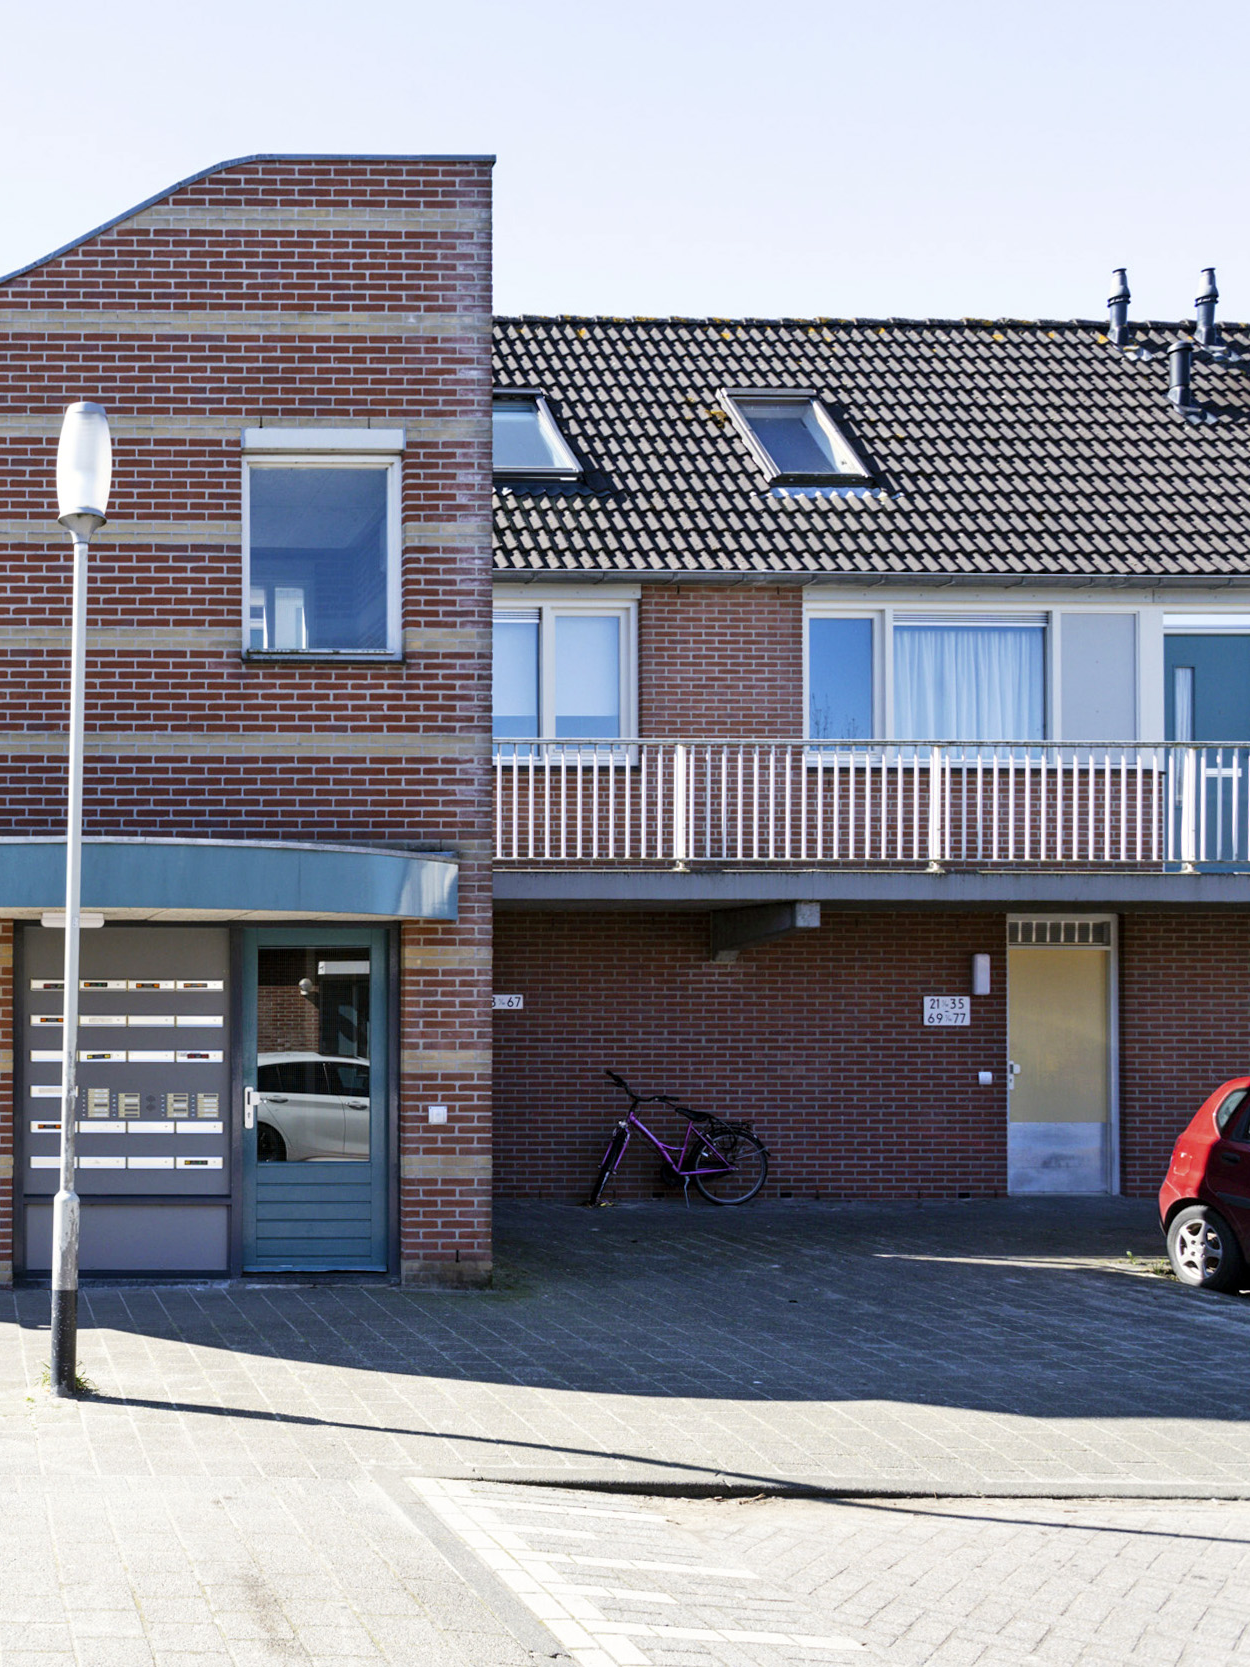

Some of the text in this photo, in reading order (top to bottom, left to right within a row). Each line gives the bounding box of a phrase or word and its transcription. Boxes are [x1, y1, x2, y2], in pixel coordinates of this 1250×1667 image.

[507, 996, 521, 1007] 67
[930, 998, 940, 1009] 21
[950, 998, 964, 1009] 35
[927, 1013, 943, 1024] 69
[953, 1013, 966, 1024] 77
